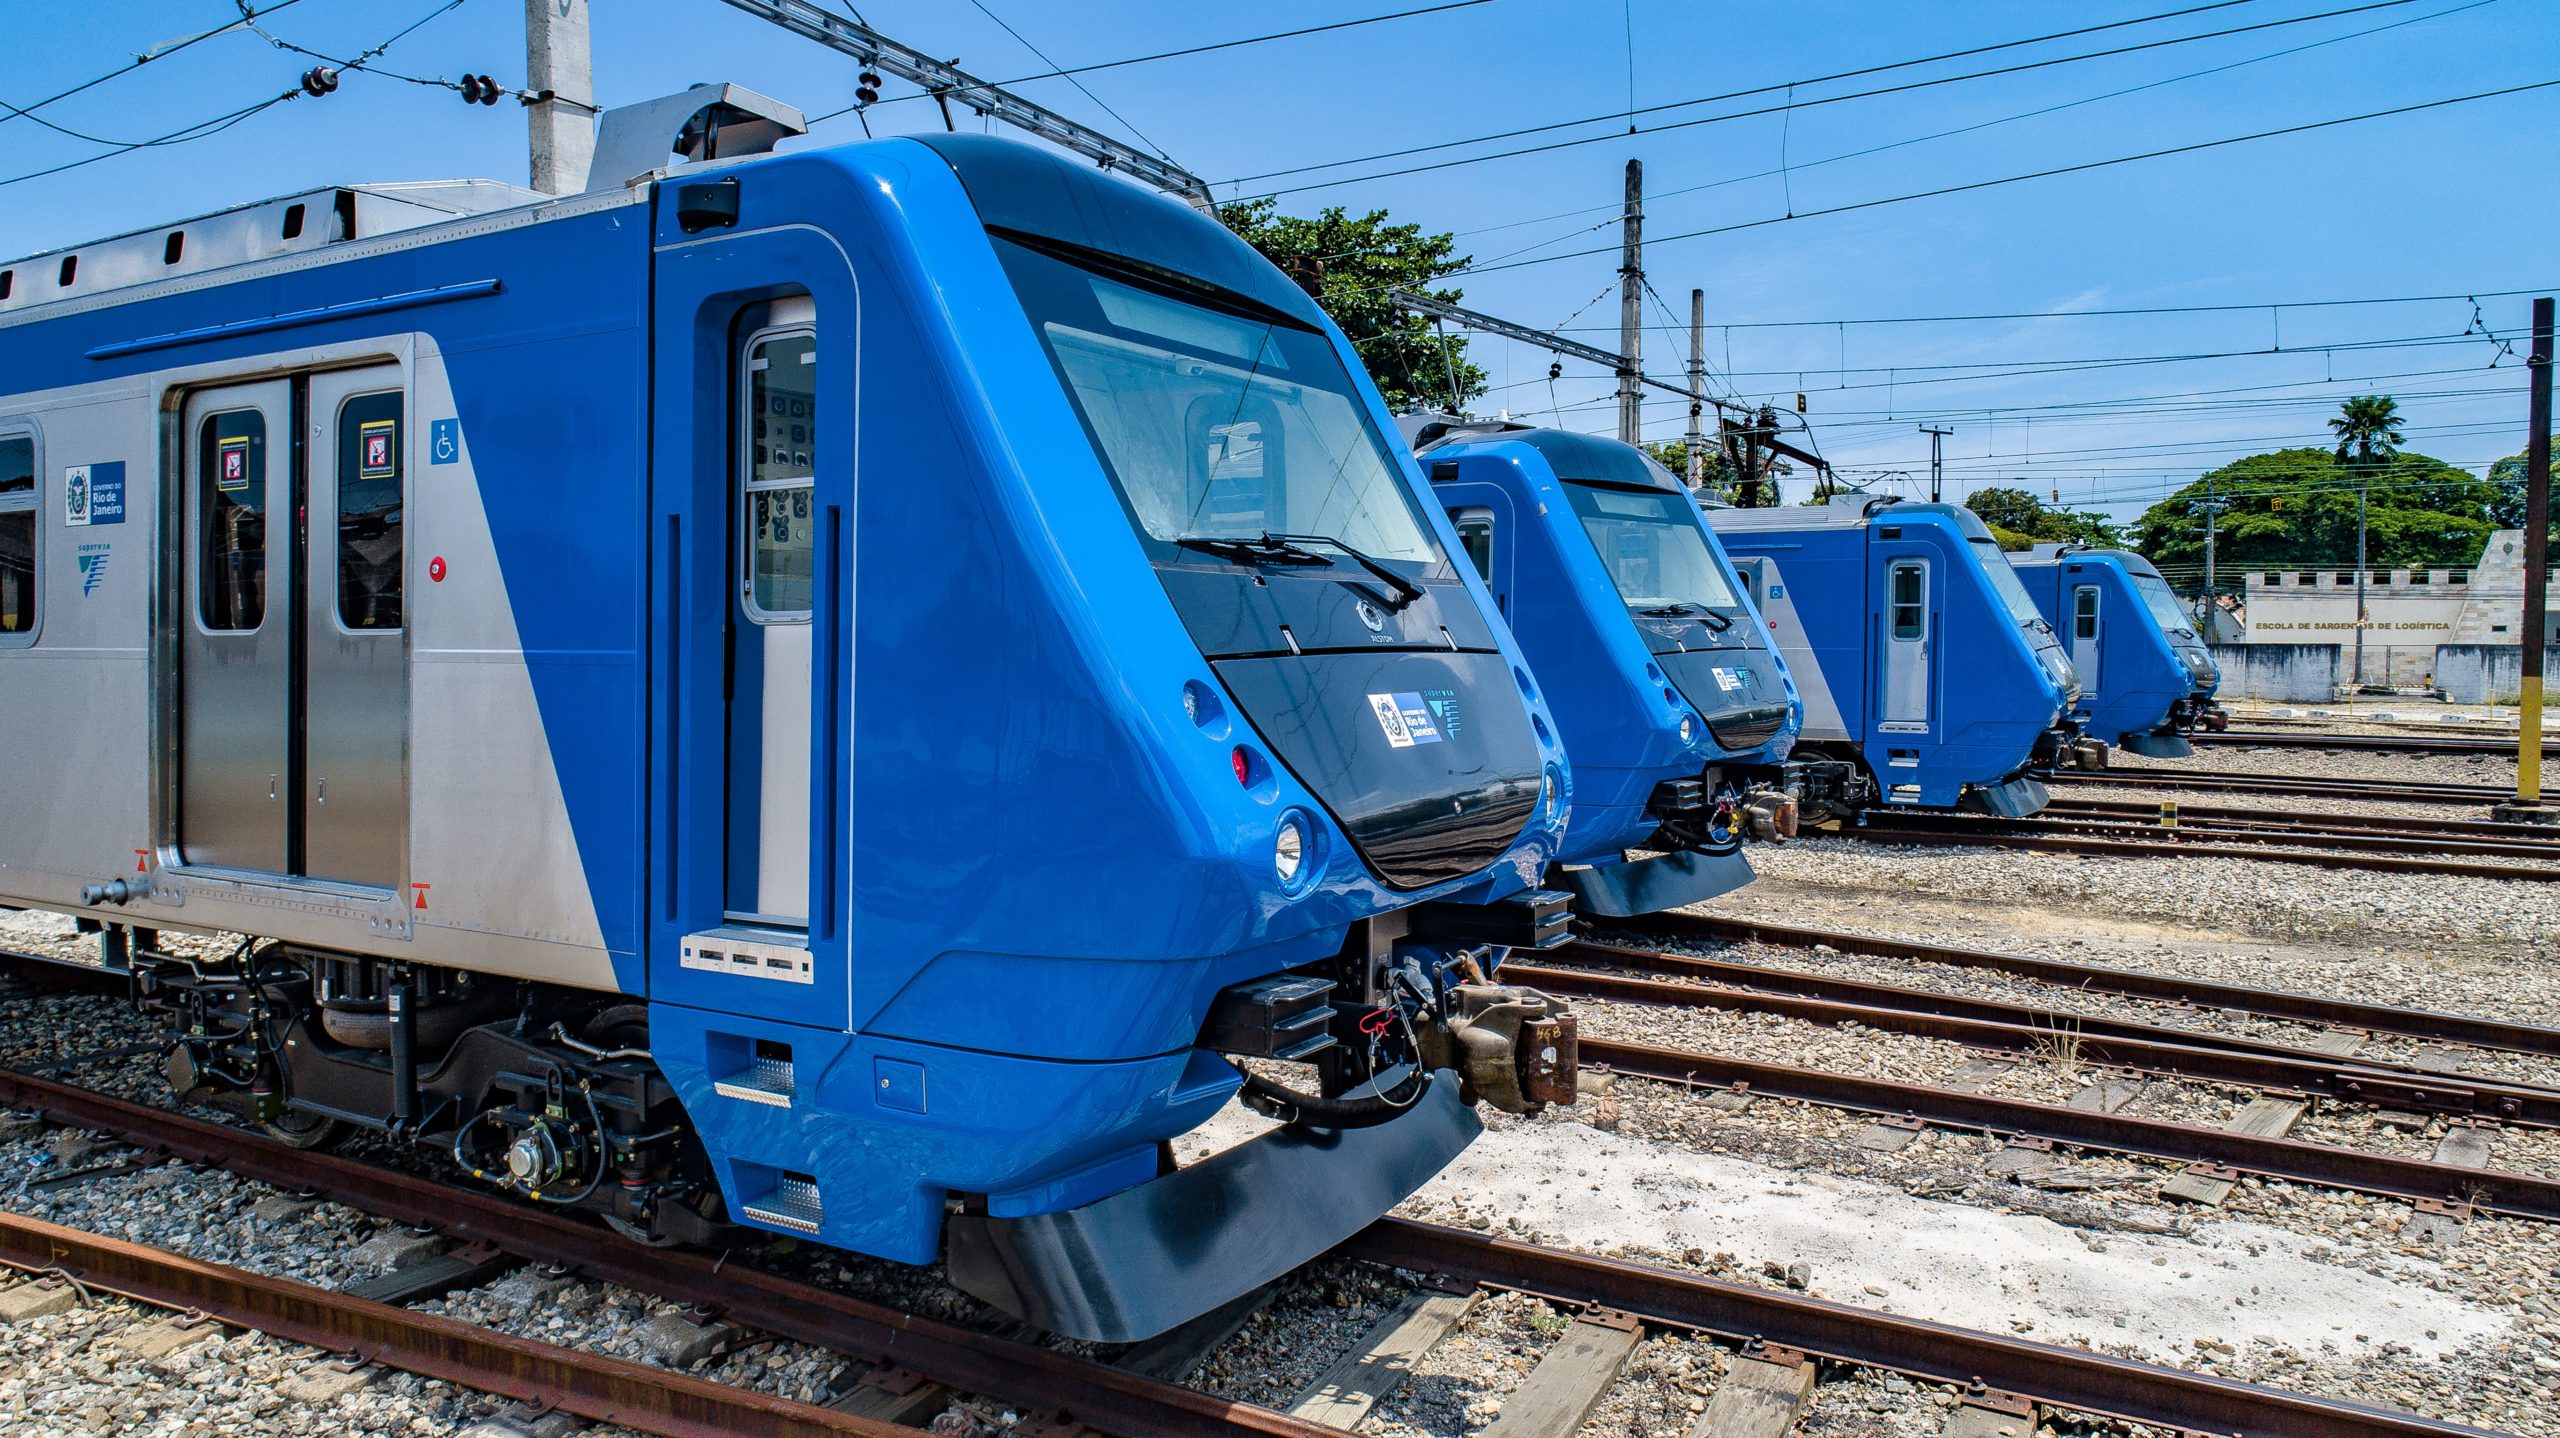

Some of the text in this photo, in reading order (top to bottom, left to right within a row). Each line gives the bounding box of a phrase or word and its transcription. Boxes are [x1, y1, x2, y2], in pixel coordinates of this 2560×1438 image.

[93, 491, 116, 503] Rio de
[93, 503, 122, 516] Janeiro
[2255, 622, 2294, 630] ESCOLA
[2298, 622, 2311, 630] DE
[2378, 622, 2391, 630] DE
[2395, 620, 2450, 630] LOGÍSTICA
[1404, 715, 1427, 727] Rio de
[1409, 725, 1437, 737] Janeiro
